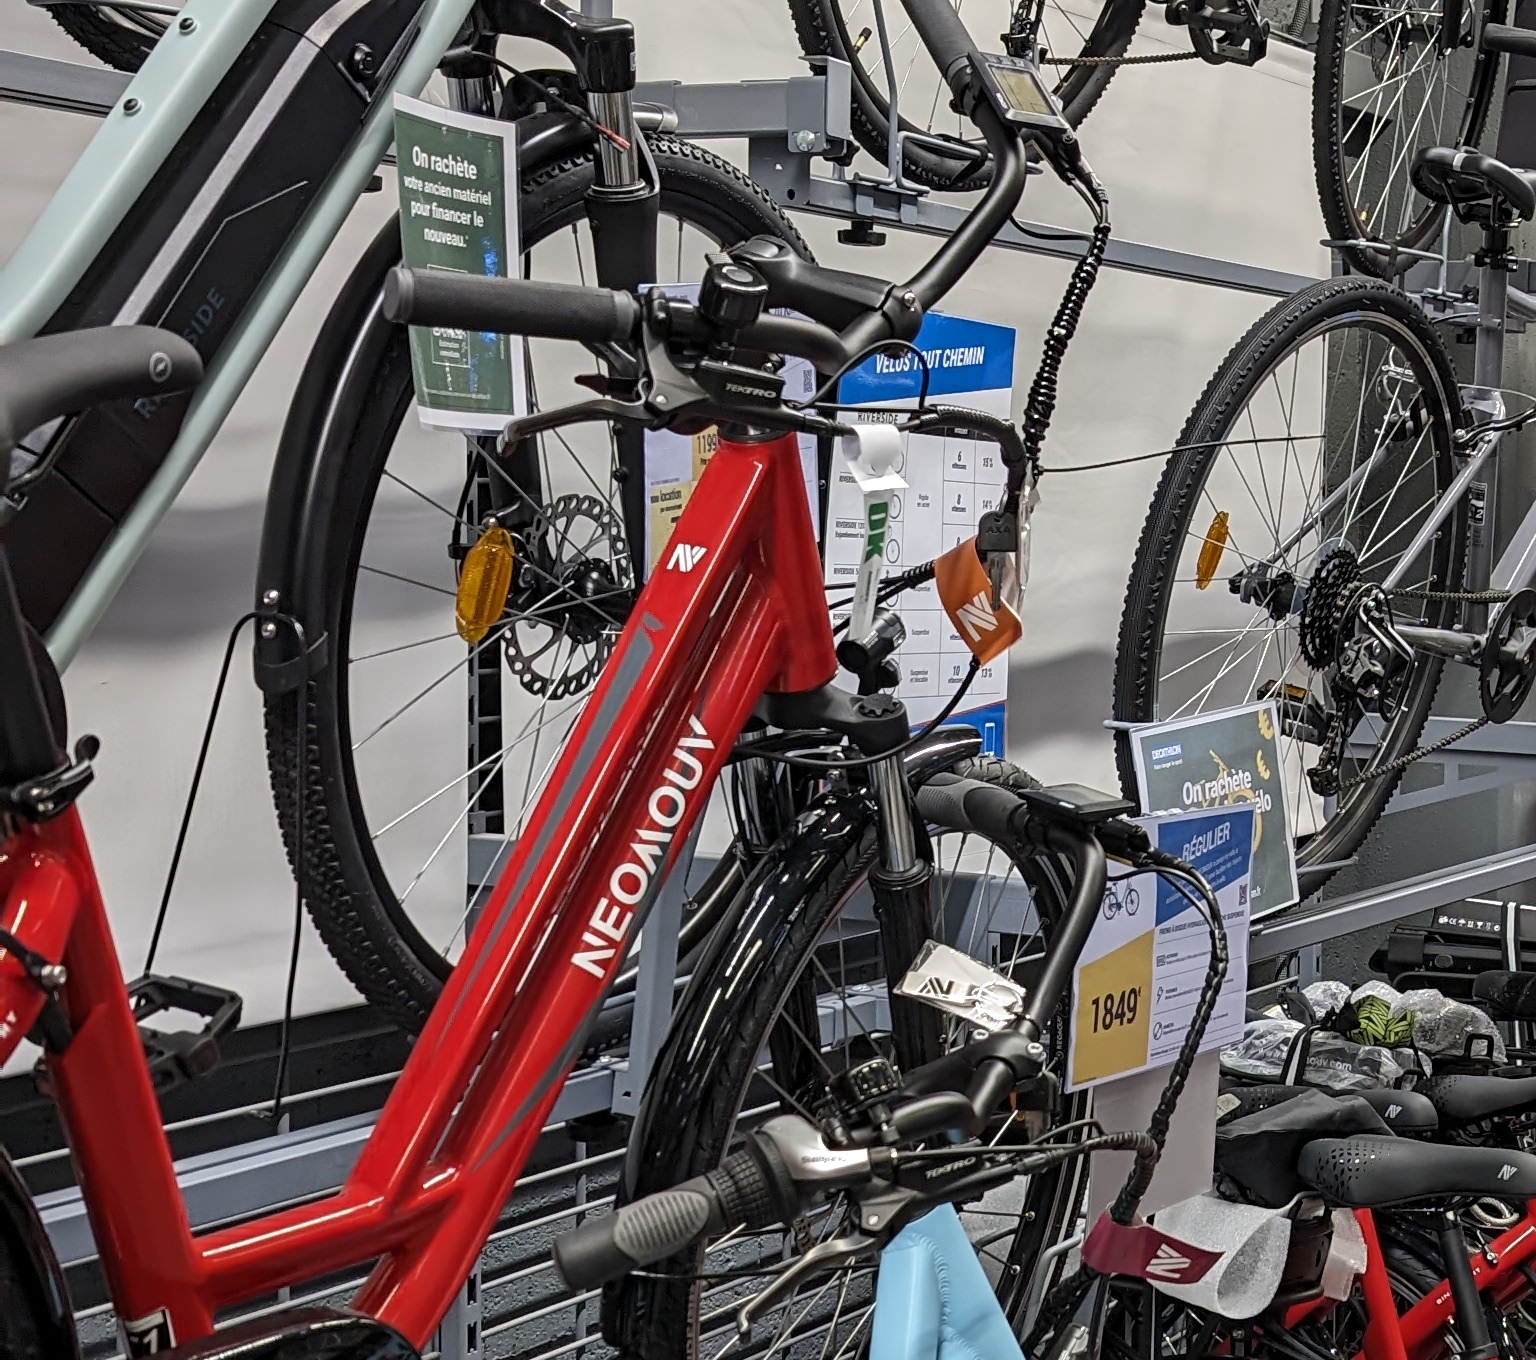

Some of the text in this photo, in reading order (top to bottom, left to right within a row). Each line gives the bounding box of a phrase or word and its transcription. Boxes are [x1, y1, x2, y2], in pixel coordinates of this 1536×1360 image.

[412, 146, 477, 181] On rachète
[403, 175, 492, 206] votre ancien matériel
[410, 199, 484, 227] pour financer le
[943, 346, 985, 368] CHEMIN
[725, 383, 776, 399] TEKTRO
[1183, 768, 1252, 805] On rachète
[1182, 821, 1231, 862] RÉGULIER
[925, 1157, 977, 1180] TEKTRO
